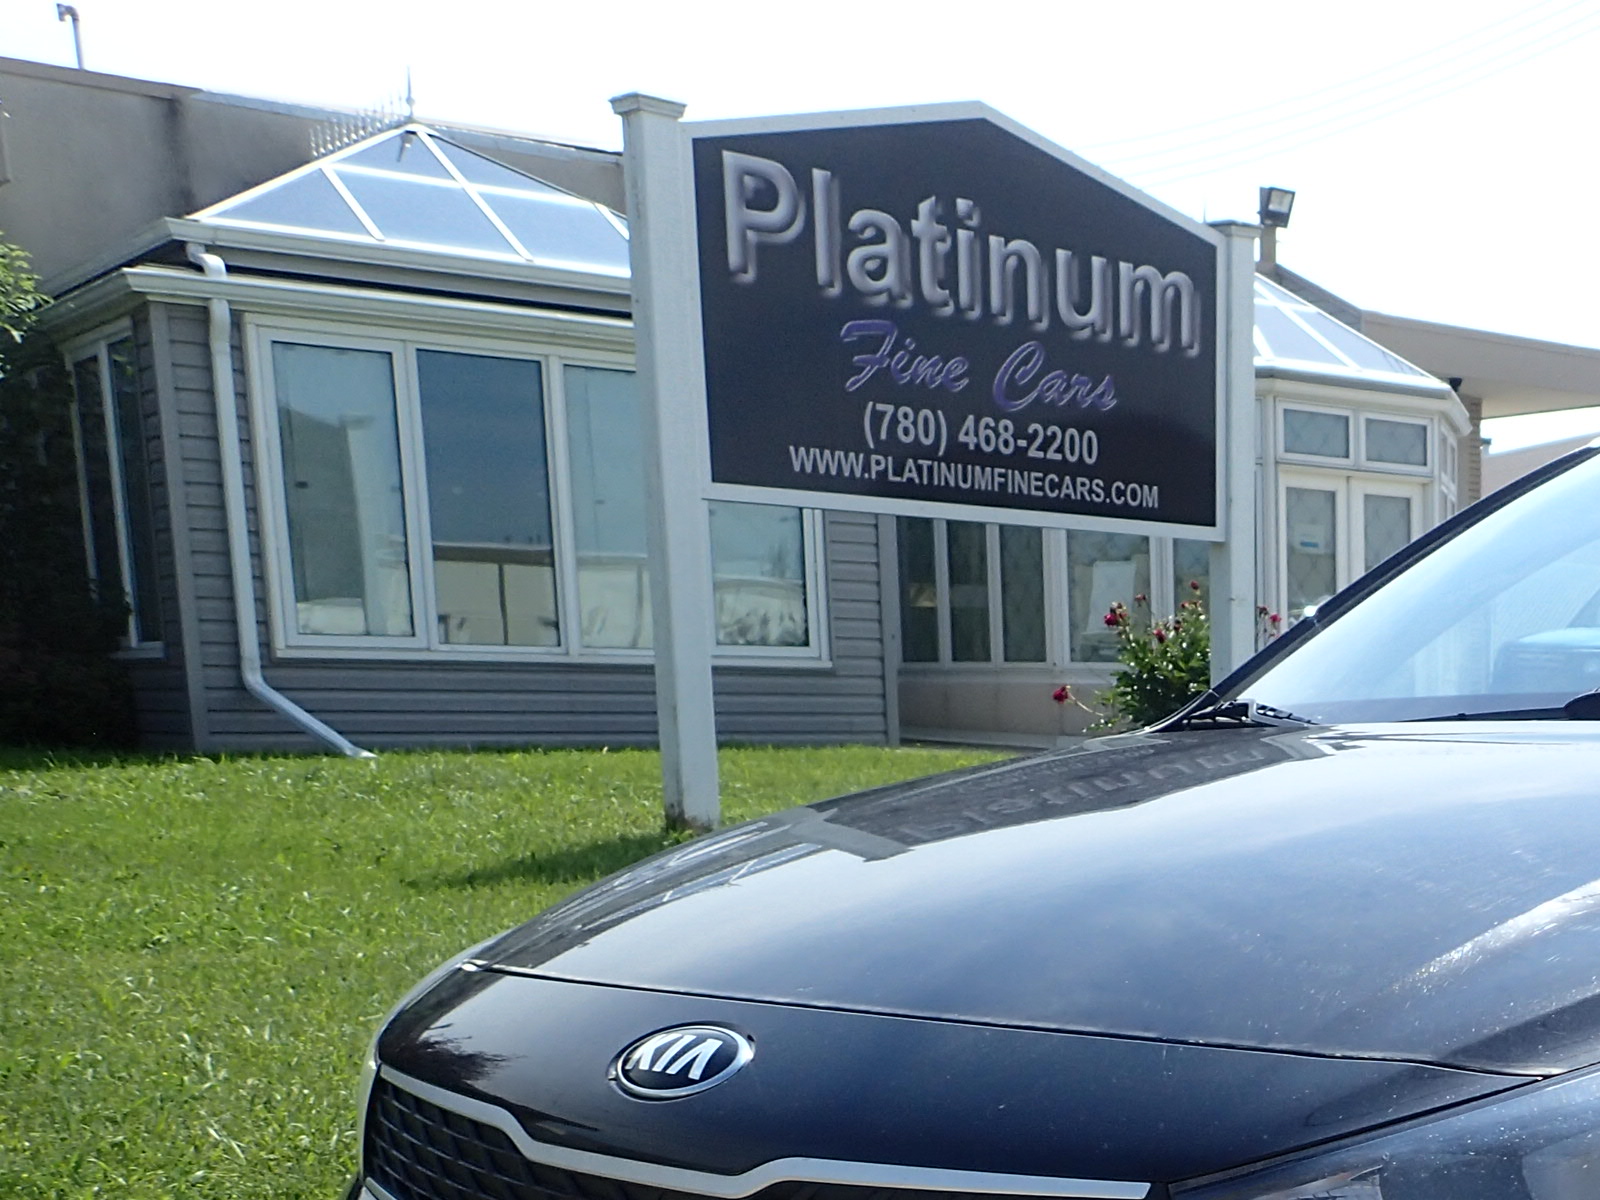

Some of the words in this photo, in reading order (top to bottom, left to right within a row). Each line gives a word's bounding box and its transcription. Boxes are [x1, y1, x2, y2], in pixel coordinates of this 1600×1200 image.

[721, 149, 1199, 356] Platinum
[840, 319, 970, 392] Fine
[993, 340, 1117, 412] Cars
[863, 400, 948, 457] (780)
[957, 413, 1100, 465] 468-2200
[789, 444, 1160, 509] WWW.PLATINUMFINECARS.COM
[624, 1032, 724, 1081] KIA
